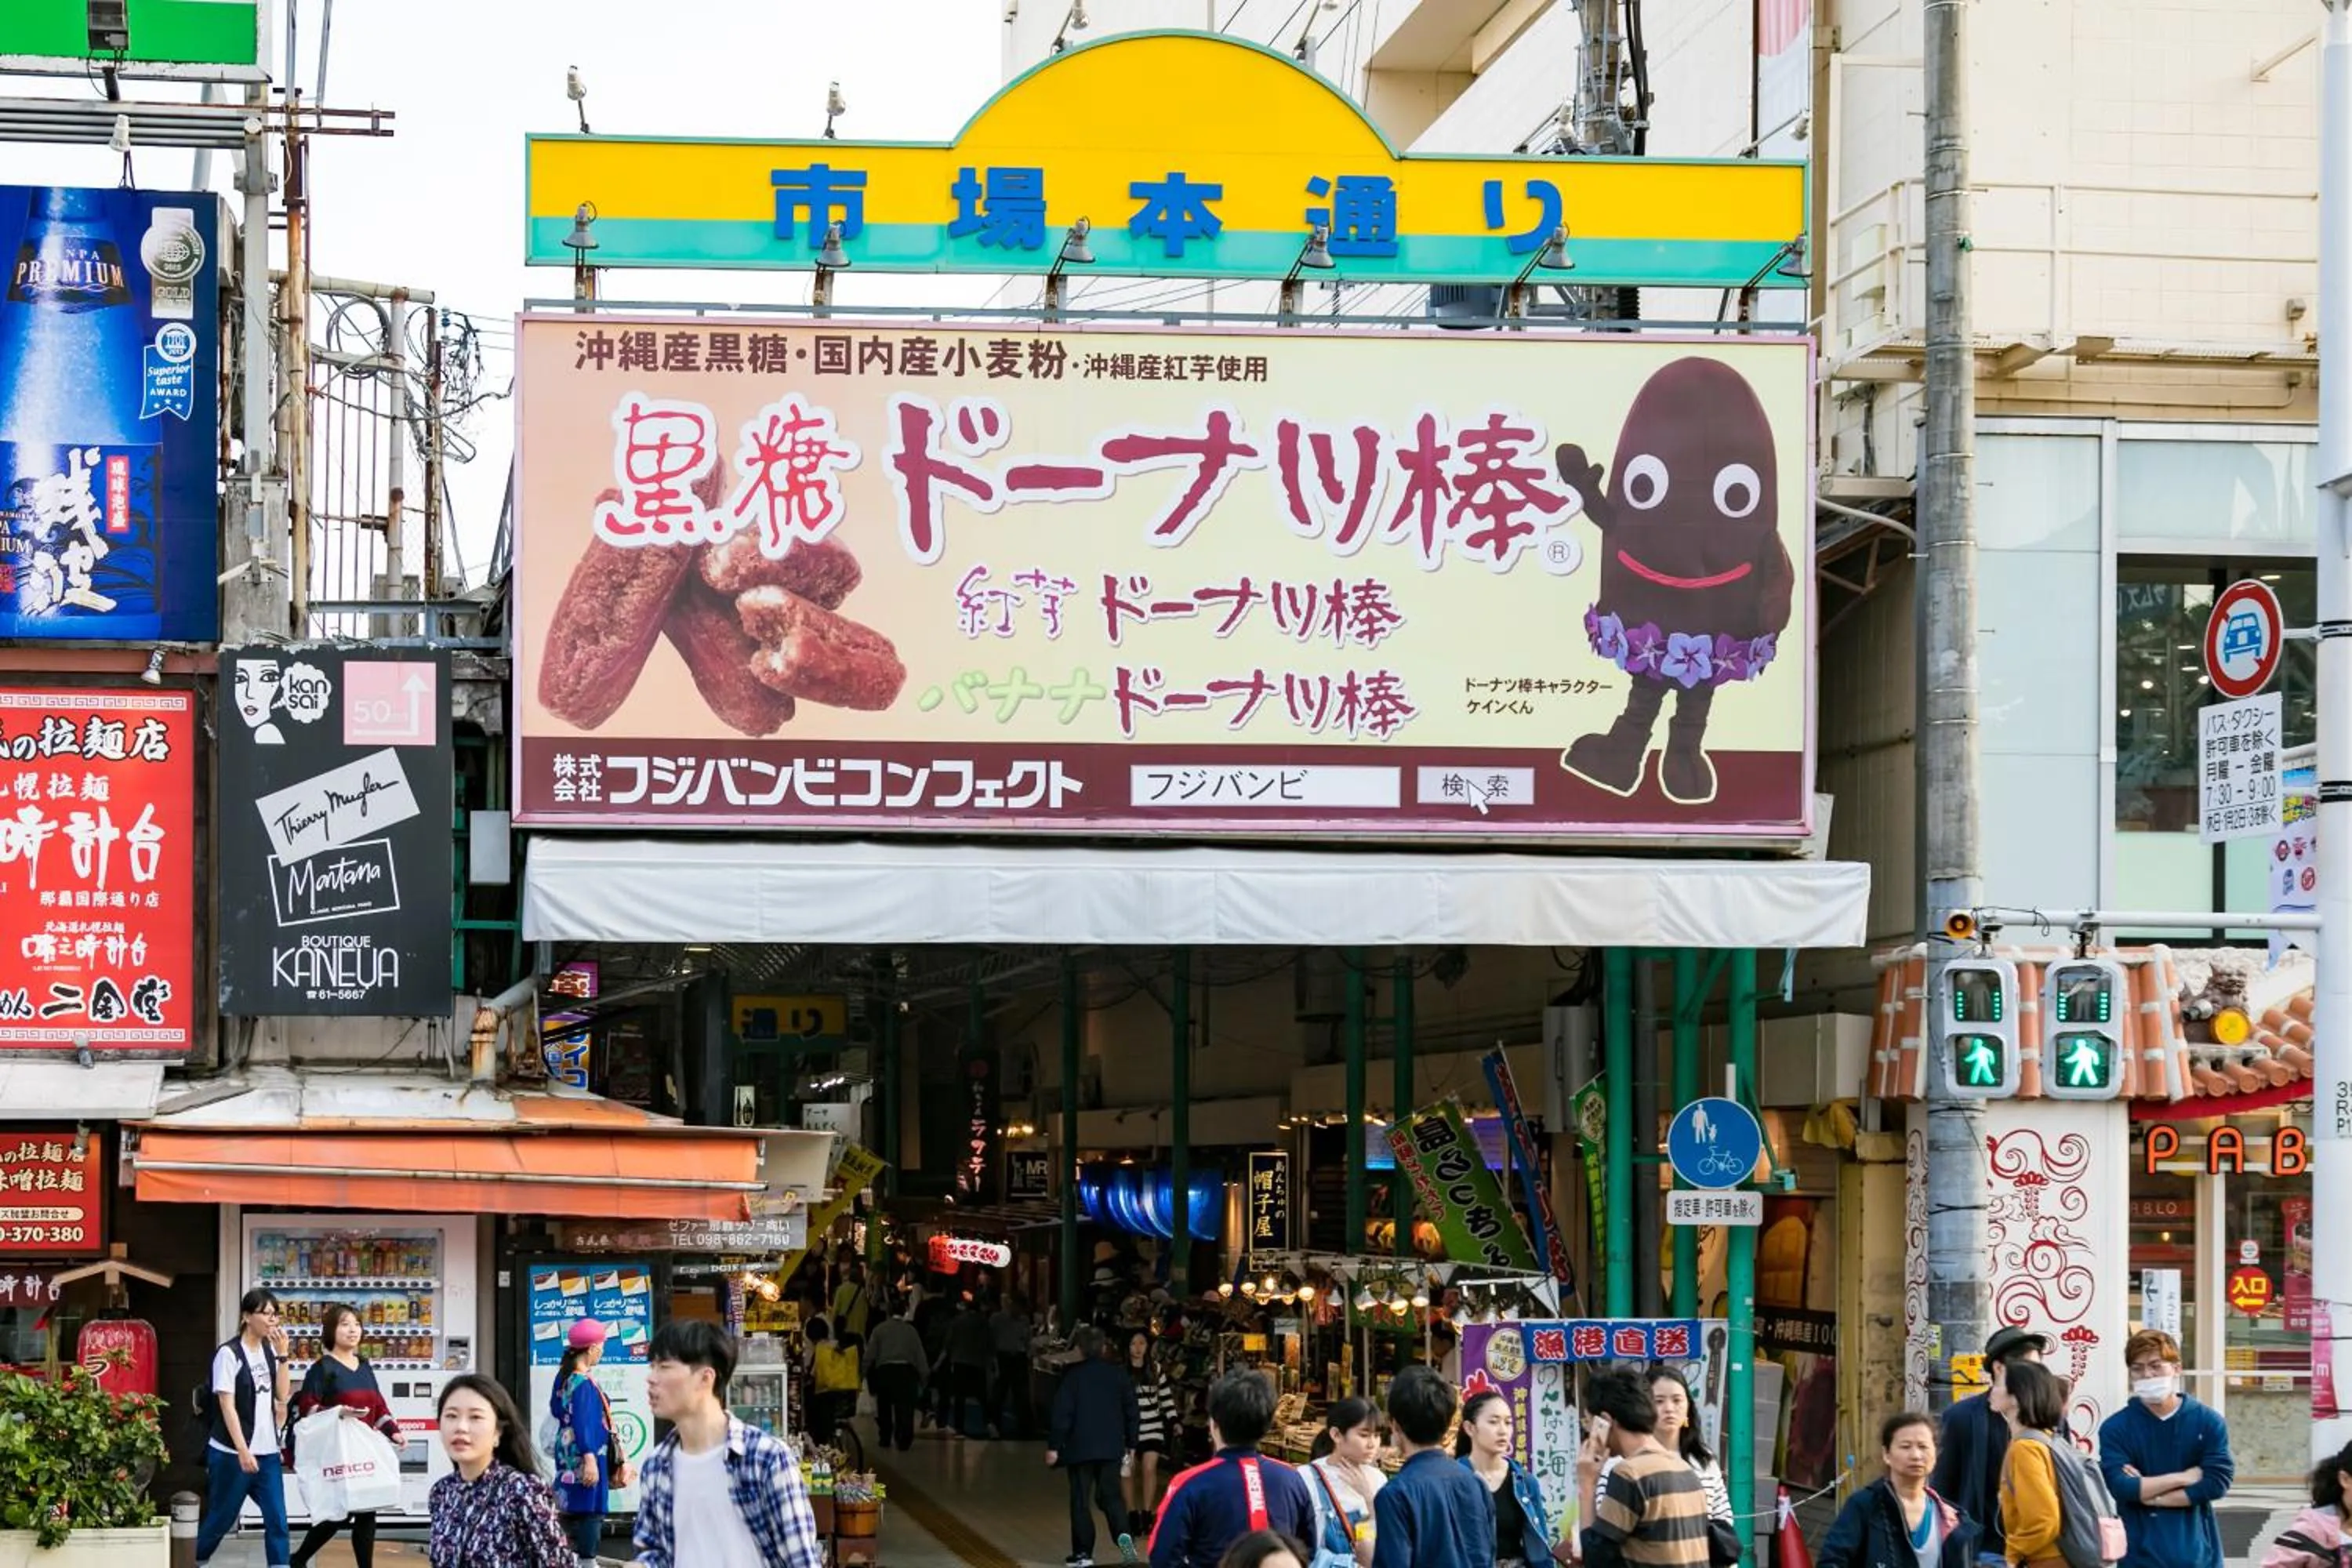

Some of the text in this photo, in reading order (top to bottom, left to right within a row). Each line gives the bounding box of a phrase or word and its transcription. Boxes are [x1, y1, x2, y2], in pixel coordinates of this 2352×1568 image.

[770, 162, 1564, 258] 市場本通り
[16, 262, 124, 287] PREMIUM
[147, 364, 191, 376] Superior
[156, 376, 182, 386] taste
[150, 388, 187, 397] AWARD
[1465, 678, 1613, 694] ドーナツ棒キャラクター
[1466, 699, 1534, 714] ケインくん
[2206, 708, 2275, 735] バス・タクシー
[2205, 728, 2275, 759] 許可車を除く
[554, 754, 601, 778] 株式
[554, 778, 601, 802] 会社
[607, 756, 1083, 809] フジバンビコンフェクト
[1147, 769, 1308, 800] フジバンビ
[1442, 773, 1509, 798] 検索
[274, 771, 400, 845] Thierry Mugler
[288, 857, 380, 913] Montana
[301, 935, 371, 948] BOUTIQUE
[0, 1142, 85, 1163] の拉麺店
[1254, 1169, 1274, 1237] 帽子屋
[672, 1234, 695, 1246] TEL
[2233, 1276, 2268, 1294] 入口
[1534, 1325, 1688, 1359] 漁港直送
